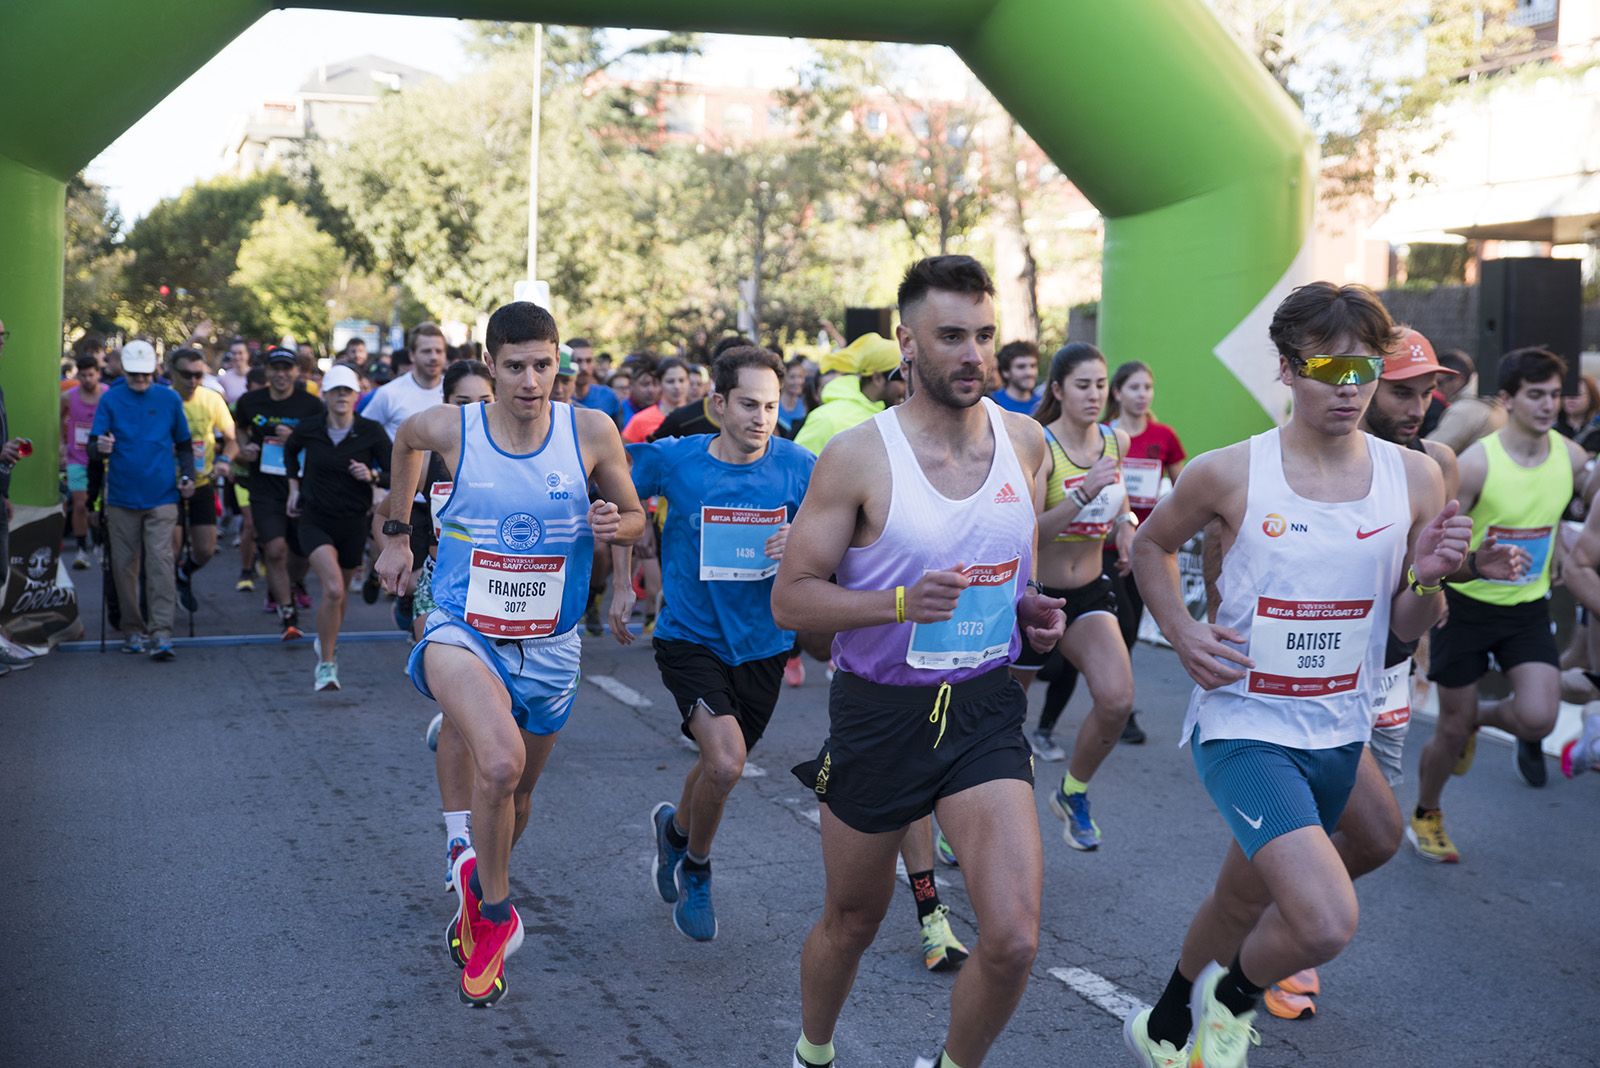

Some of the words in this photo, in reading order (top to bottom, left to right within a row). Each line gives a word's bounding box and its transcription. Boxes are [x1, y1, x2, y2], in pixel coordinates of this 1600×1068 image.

[549, 491, 569, 500] 100
[711, 514, 731, 522] MITJA
[1291, 522, 1308, 533] NN
[735, 547, 756, 559] 1436
[480, 559, 501, 568] MITJA
[502, 562, 522, 570] SANT
[488, 579, 547, 598] FRANCESC
[504, 601, 527, 613] 3072
[1266, 606, 1294, 617] MITJA
[1296, 609, 1321, 618] SANT
[1321, 608, 1352, 618] CUGAT
[1352, 608, 1364, 616] 23
[957, 621, 984, 636] 1373
[1286, 632, 1342, 651] BATISTE
[1297, 655, 1326, 669] 3053
